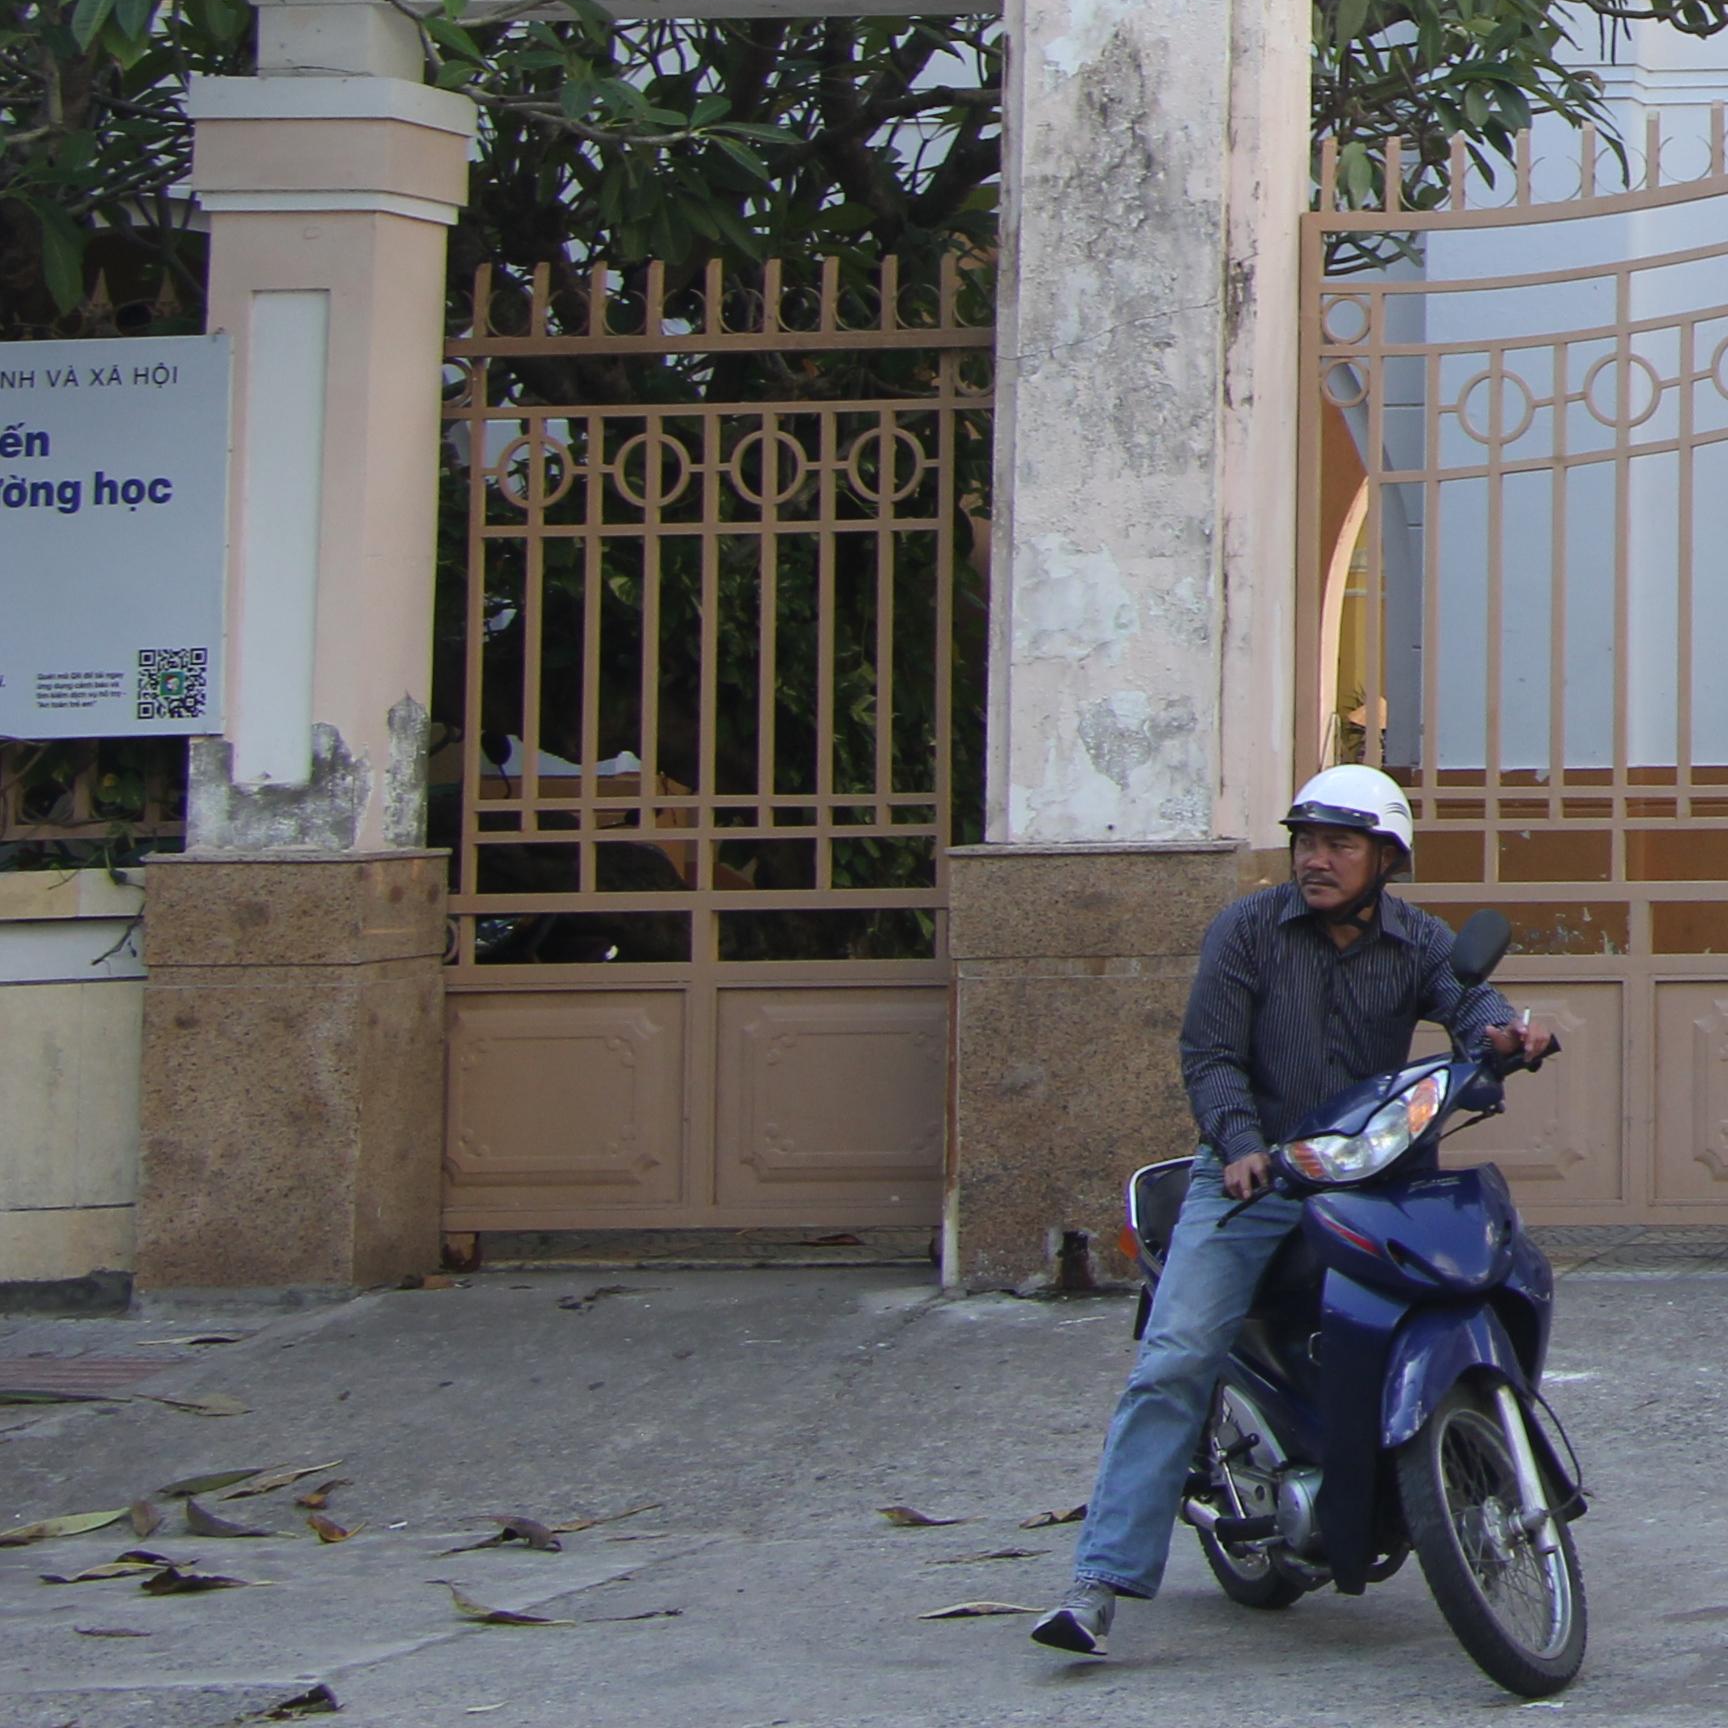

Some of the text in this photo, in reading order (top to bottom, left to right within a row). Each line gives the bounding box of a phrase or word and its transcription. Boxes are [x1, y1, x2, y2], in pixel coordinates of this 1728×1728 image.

[46, 365, 79, 388] VÀ
[89, 364, 122, 387] XÃ
[134, 362, 178, 389] HỘI
[0, 471, 173, 514] ờng học
